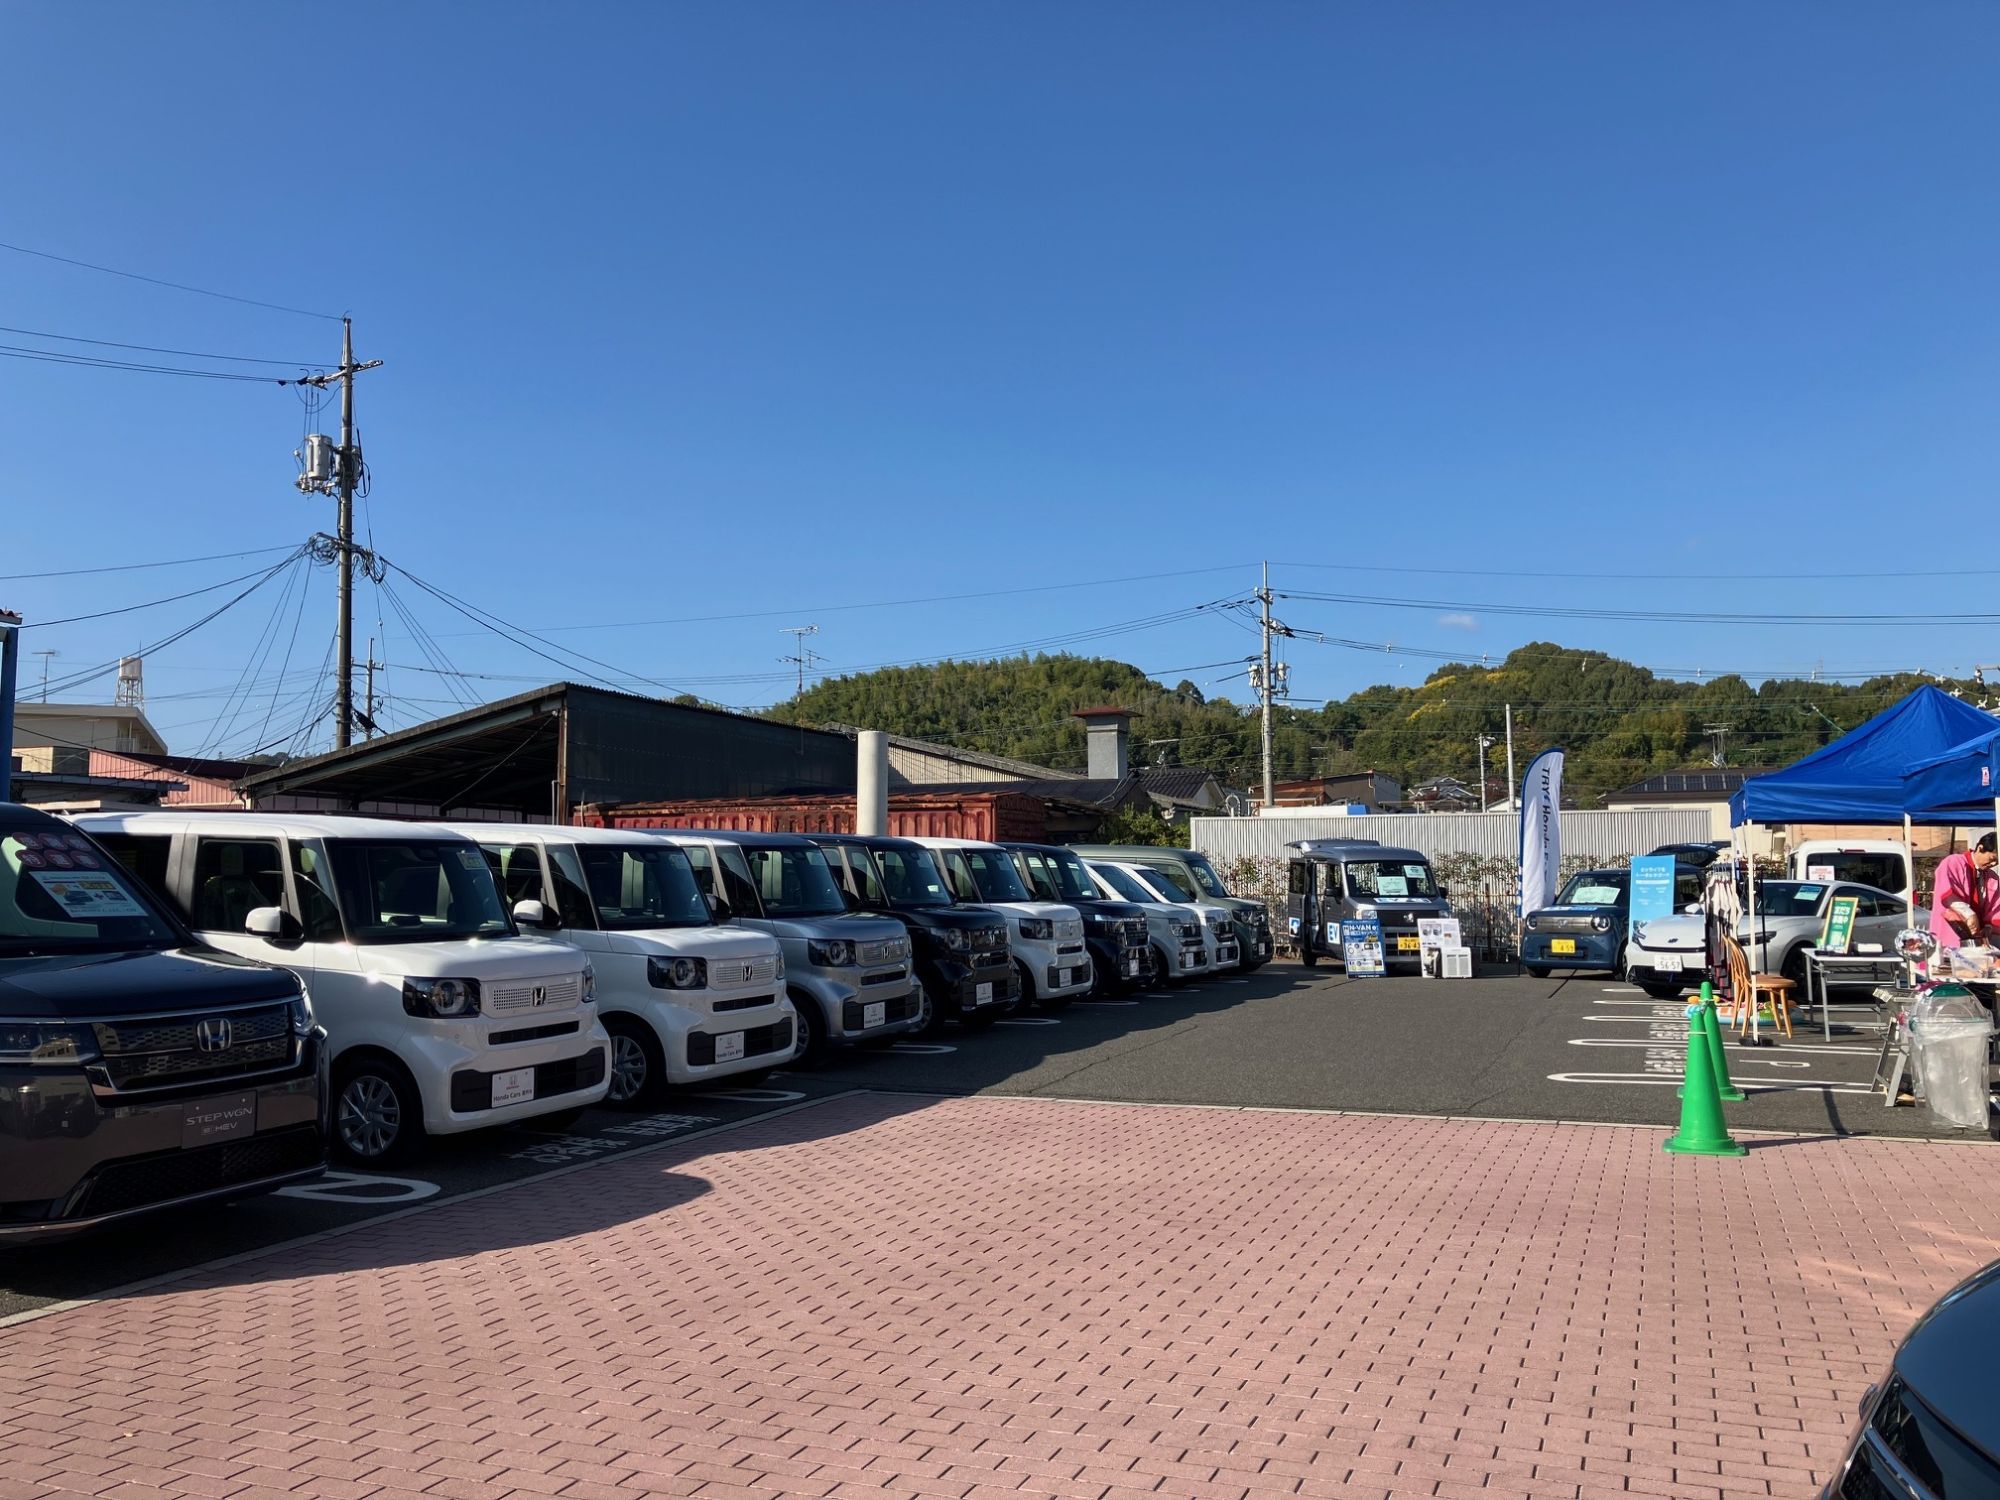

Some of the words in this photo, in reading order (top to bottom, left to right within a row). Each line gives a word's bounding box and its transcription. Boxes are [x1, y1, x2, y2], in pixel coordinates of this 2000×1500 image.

[1542, 804, 1551, 849] Honda
[493, 1094, 510, 1102] Honda
[510, 1091, 521, 1099] Cars
